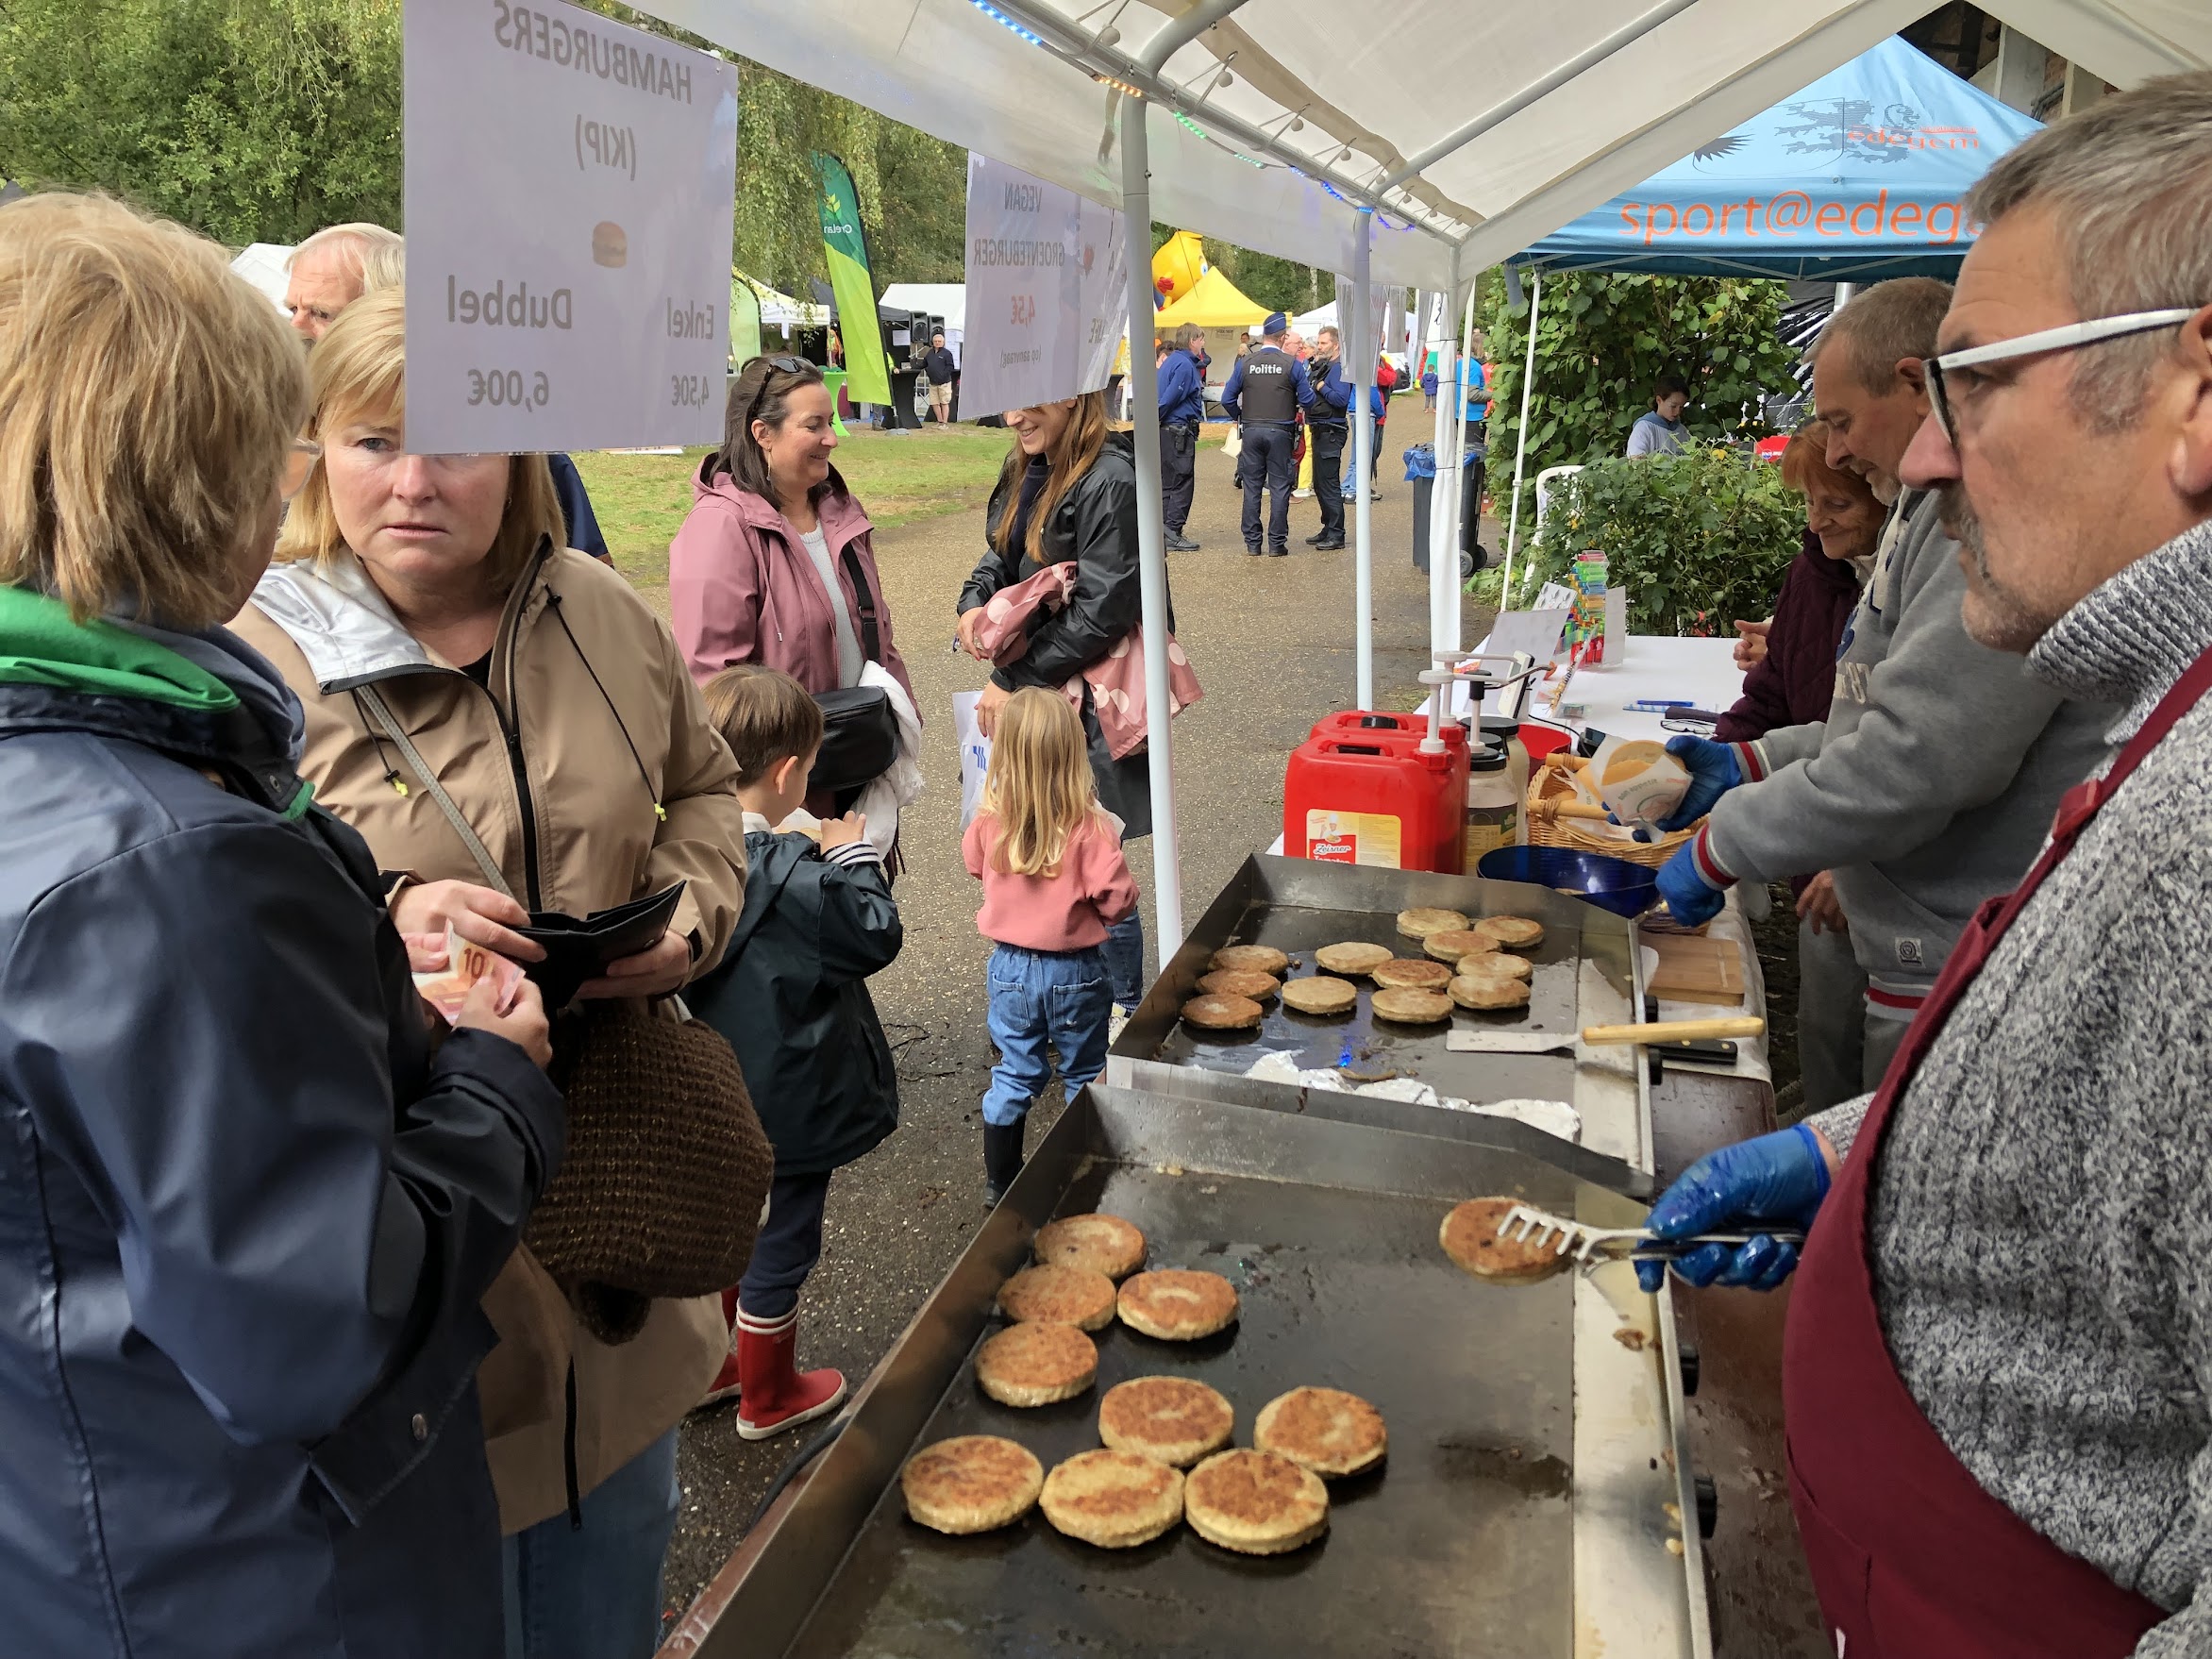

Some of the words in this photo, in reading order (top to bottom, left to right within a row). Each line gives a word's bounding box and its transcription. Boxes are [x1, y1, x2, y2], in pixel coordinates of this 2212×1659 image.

[1848, 127, 1980, 150] edegem
[1618, 189, 1980, 244] sport@edeg
[1249, 363, 1282, 375] Politie
[1315, 844, 1350, 854] Zeisner
[462, 947, 486, 980] 10
